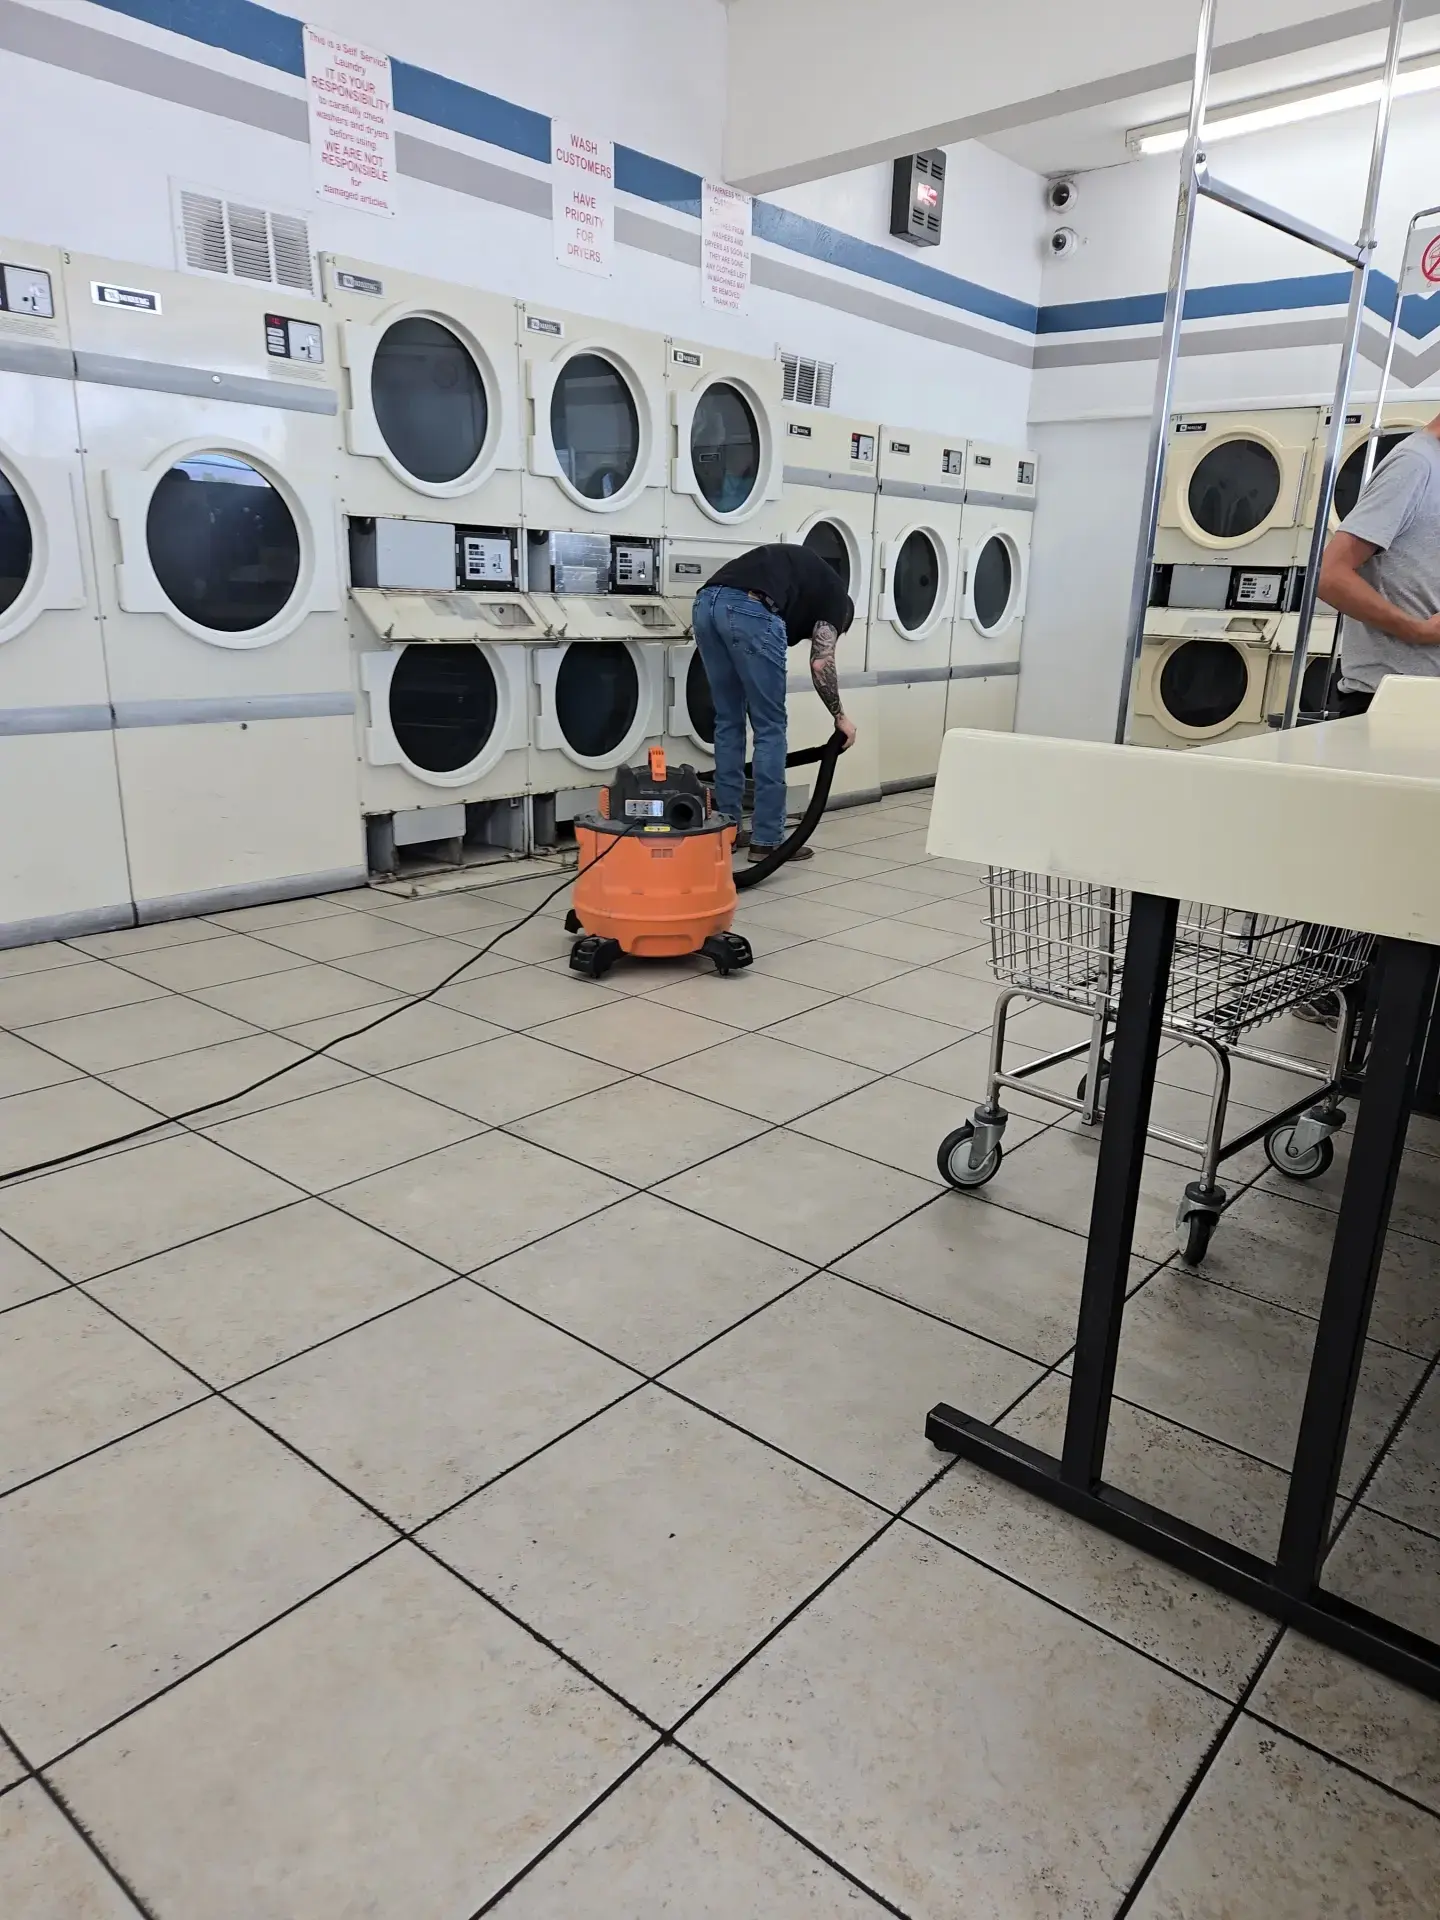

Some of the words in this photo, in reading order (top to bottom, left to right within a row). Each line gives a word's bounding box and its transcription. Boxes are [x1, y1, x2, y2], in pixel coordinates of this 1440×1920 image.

[308, 31, 325, 45] This
[342, 44, 358, 56] Self
[360, 50, 387, 68] Service
[334, 55, 366, 76] Laundry
[326, 66, 335, 80] IT
[337, 72, 347, 84] IS
[349, 76, 376, 94] YOUR
[312, 75, 389, 112] RESPONSIBILITY
[318, 96, 326, 104] to
[328, 100, 360, 118] carefully
[316, 110, 348, 126] washers
[350, 120, 365, 132] and
[366, 126, 390, 140] dryers
[329, 125, 355, 142] before
[356, 138, 376, 152] using
[570, 134, 598, 156] WASH
[324, 140, 340, 154] WE
[343, 146, 362, 161] ARE
[364, 152, 384, 168] NOT
[556, 148, 612, 179] CUSTOMERS
[322, 152, 388, 182] RESPONSIBLE
[350, 176, 362, 187] for
[712, 184, 734, 198] FAIRNESS
[324, 184, 358, 200] damaged
[573, 190, 596, 210] HAVE
[565, 206, 604, 229] PRIORITY
[576, 228, 594, 244] FOR
[64, 252, 70, 264] 3
[704, 239, 722, 251] DRYERS
[730, 246, 742, 258] SOON
[709, 252, 720, 260] THEY
[713, 276, 736, 288] MACHINES
[716, 264, 736, 276] CLOTHES
[737, 272, 748, 280] LEFT
[713, 296, 728, 306] THANK
[718, 287, 740, 300] REMOVED
